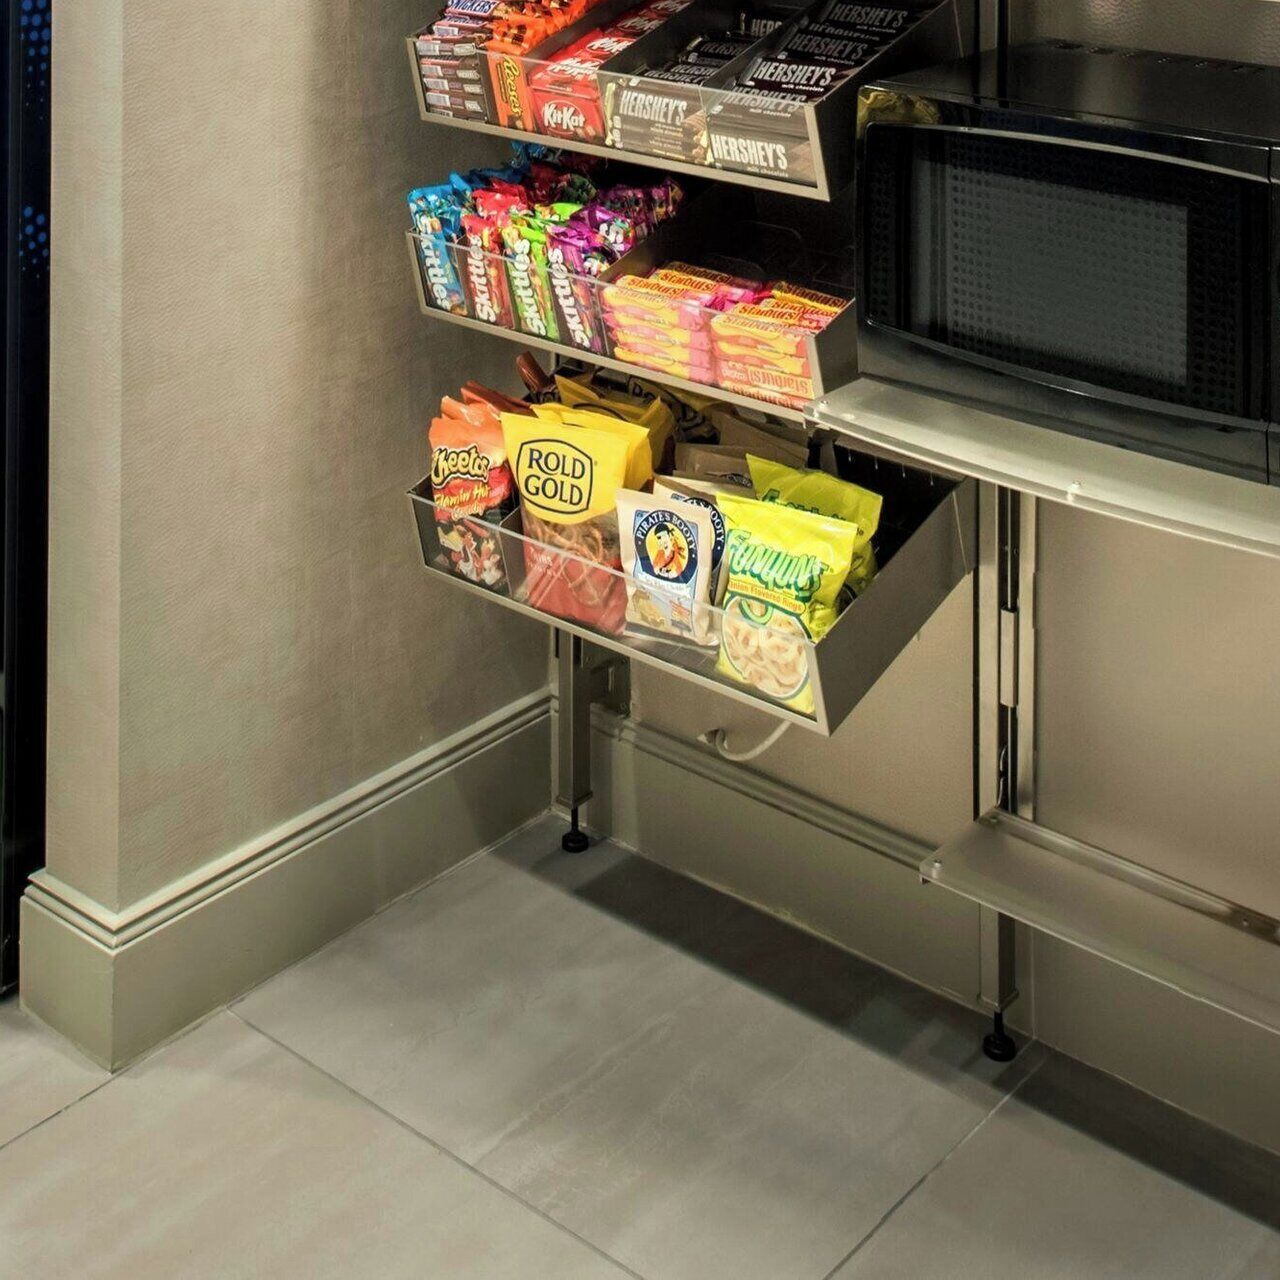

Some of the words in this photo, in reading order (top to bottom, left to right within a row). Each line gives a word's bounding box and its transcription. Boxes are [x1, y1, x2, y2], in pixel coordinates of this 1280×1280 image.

[832, 3, 908, 28] HERSHEY'S
[788, 33, 869, 60] HERSHEY'S
[757, 58, 837, 86] HERSHEY'S
[620, 89, 688, 126] HERSHEY'S
[711, 133, 789, 171] HERSHEY'S
[528, 448, 586, 481] ROLD
[524, 473, 584, 506] GOLD
